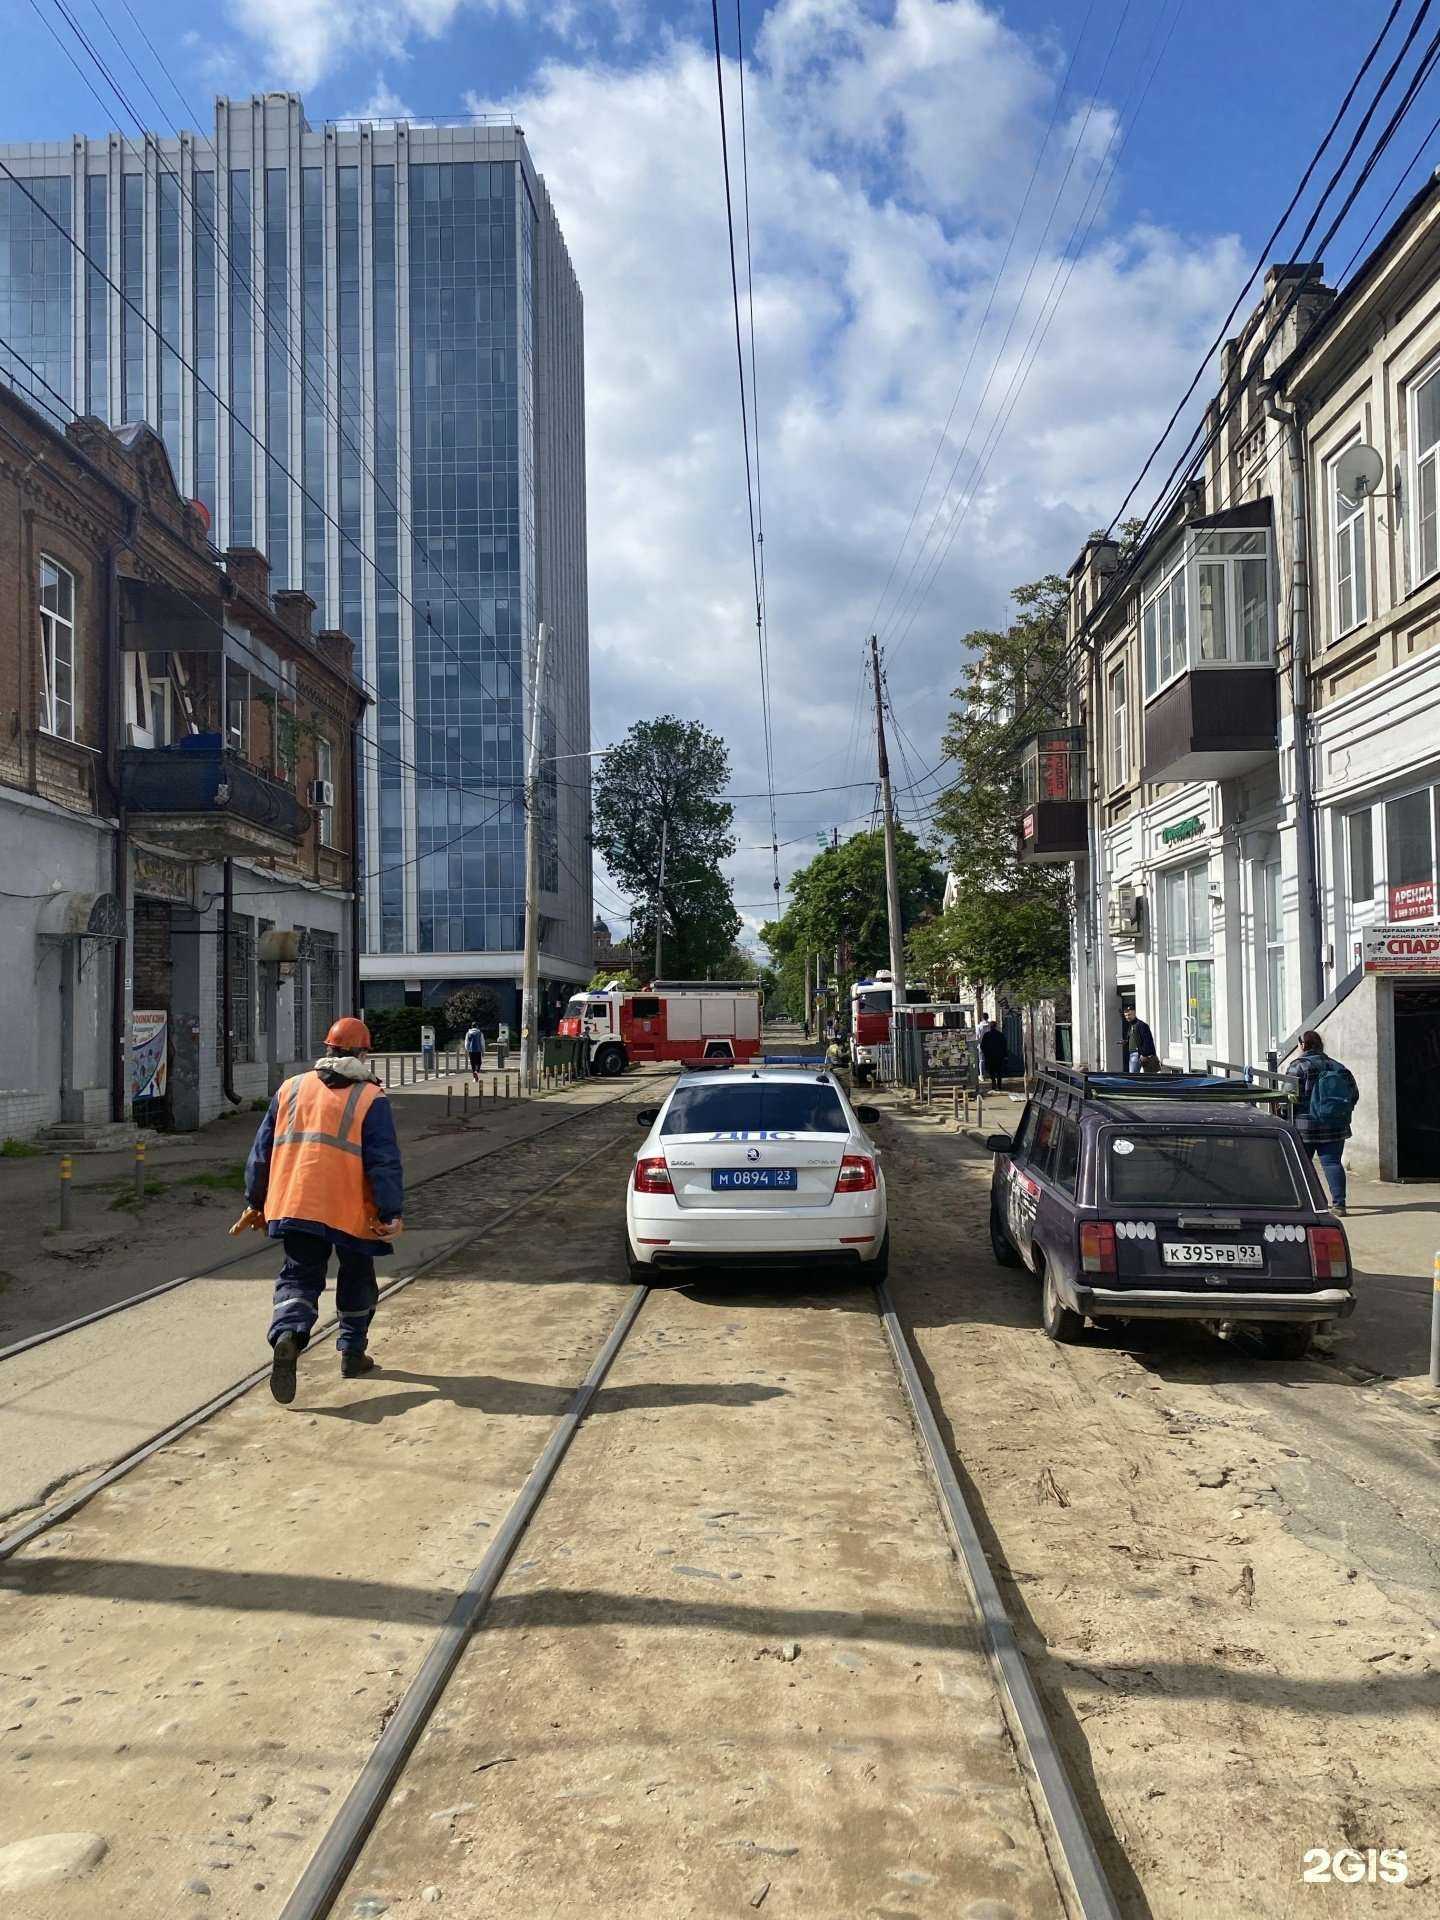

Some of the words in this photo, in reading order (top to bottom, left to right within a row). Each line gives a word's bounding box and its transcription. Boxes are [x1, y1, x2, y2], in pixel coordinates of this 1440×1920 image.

[1395, 886, 1432, 904] АРЕНДА
[1387, 940, 1440, 954] СПАР
[733, 1172, 768, 1184] 0894
[777, 1171, 790, 1180] 23
[1239, 1246, 1256, 1258] 93
